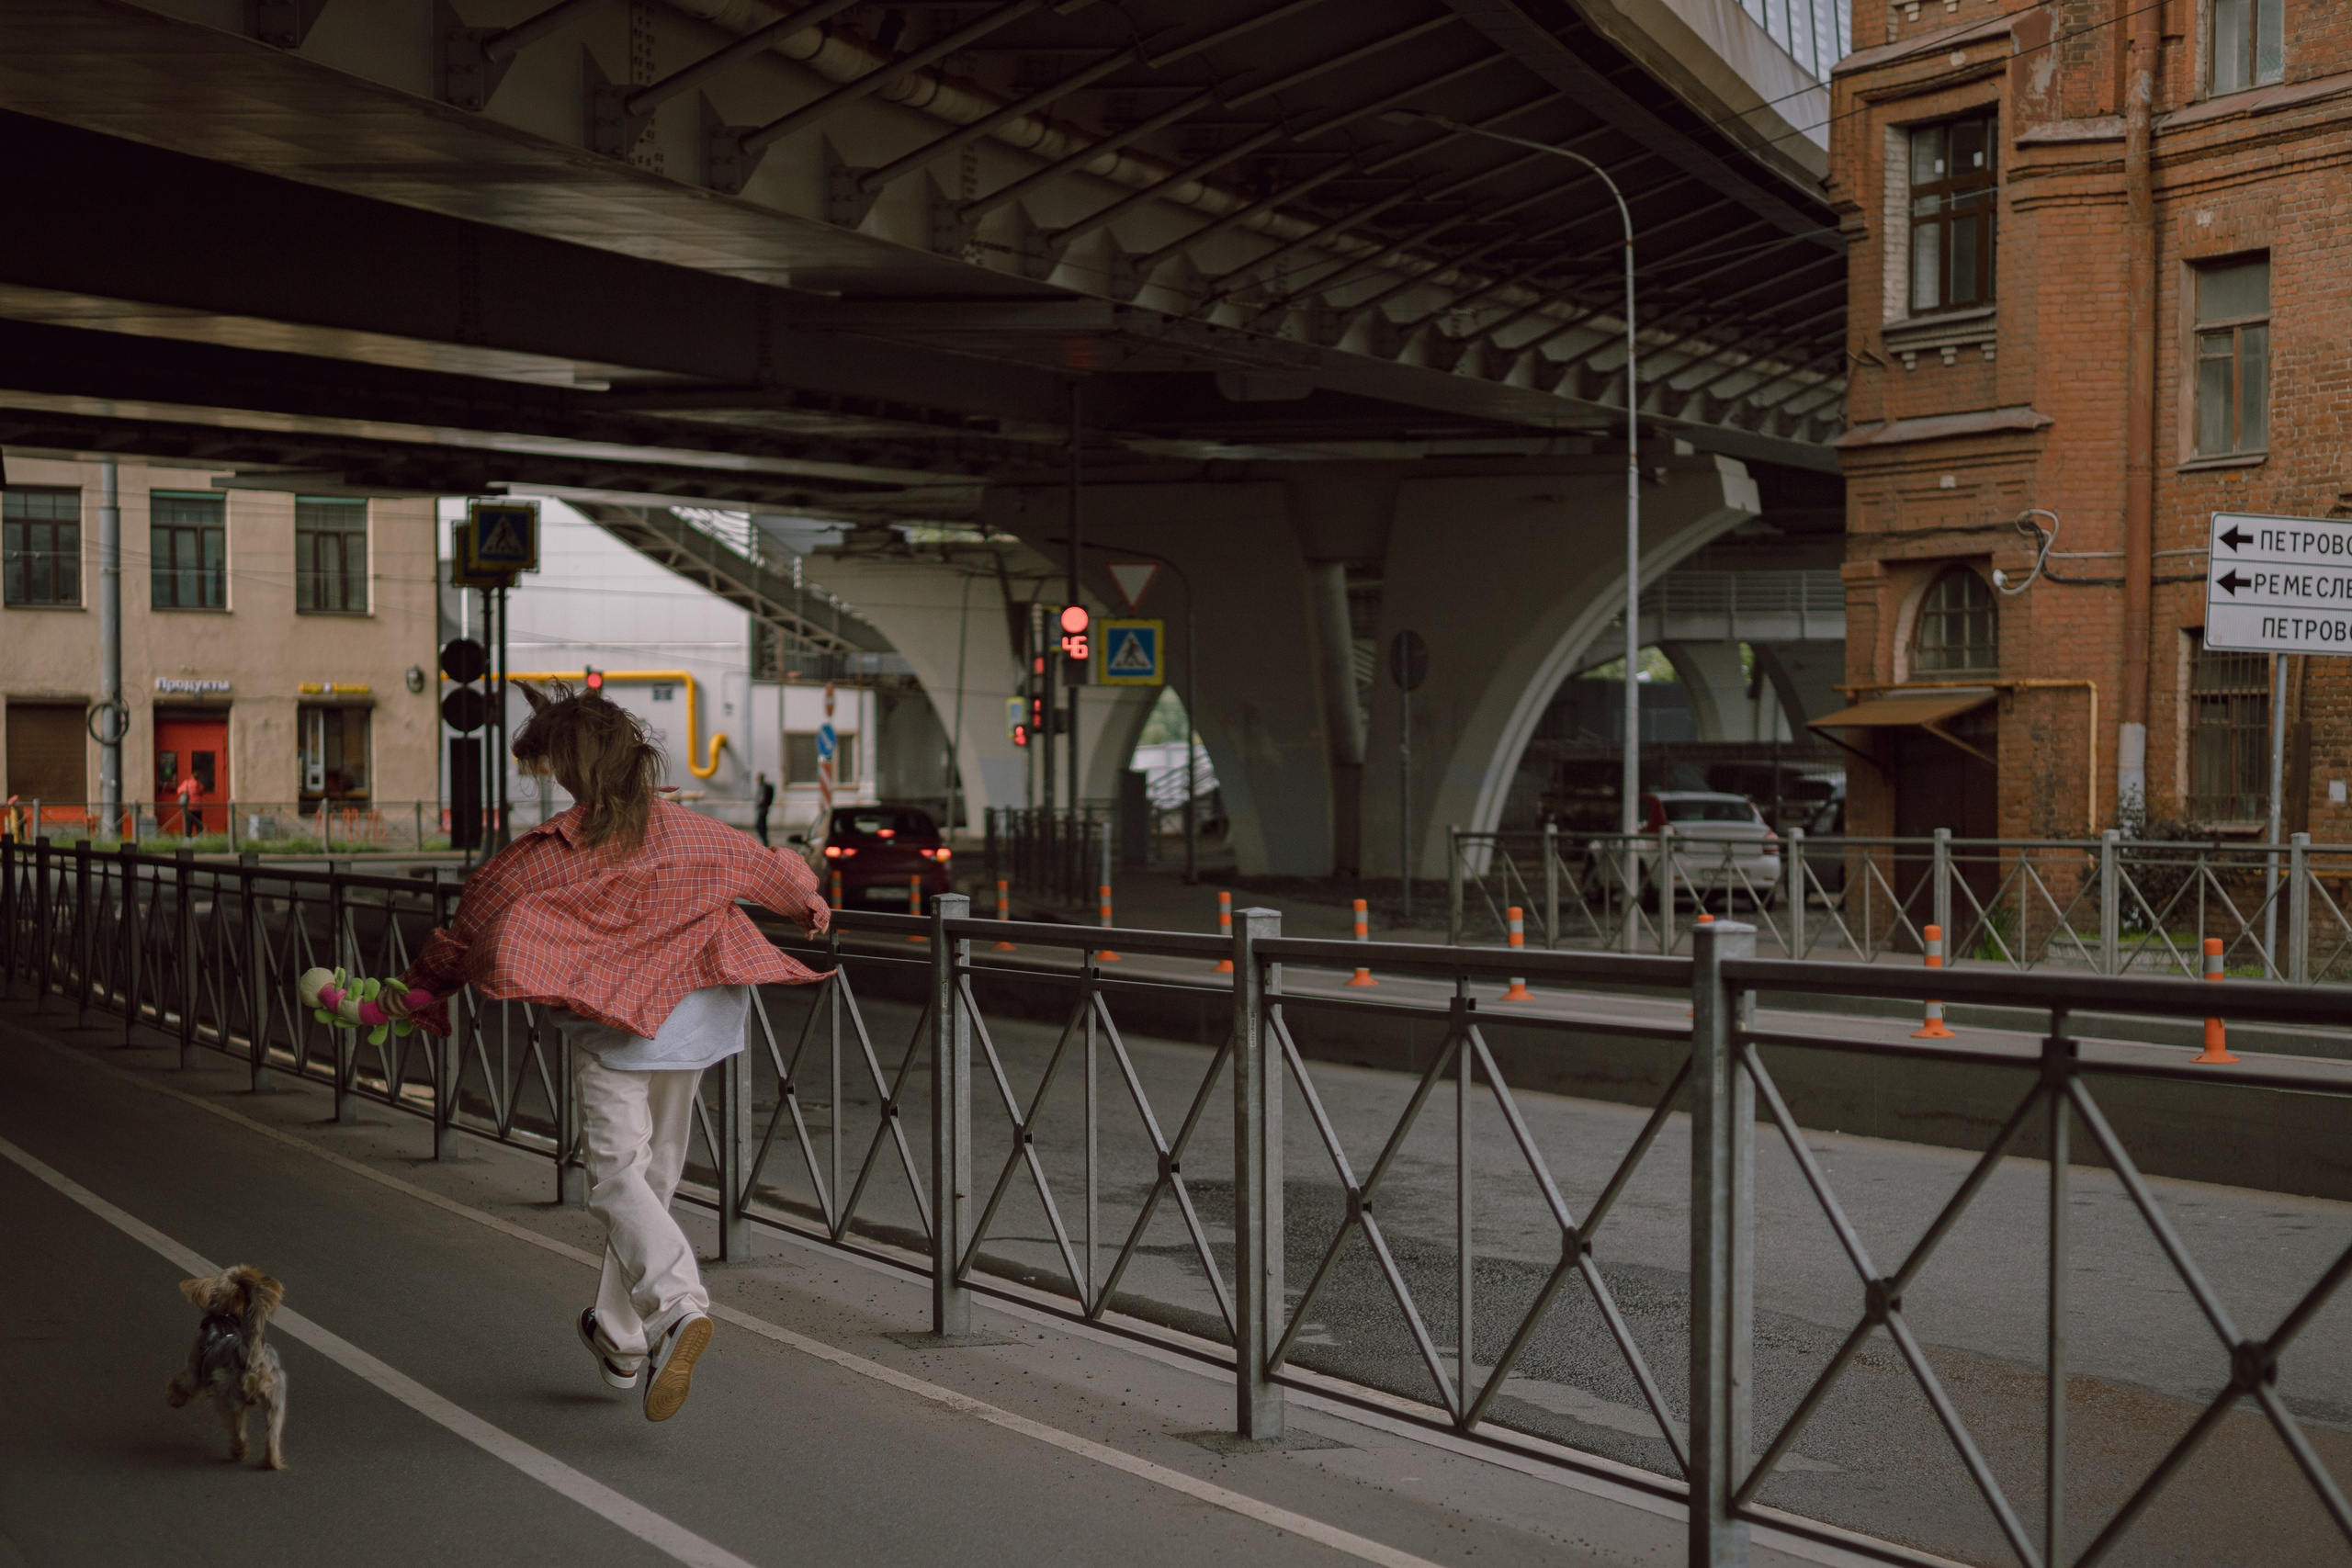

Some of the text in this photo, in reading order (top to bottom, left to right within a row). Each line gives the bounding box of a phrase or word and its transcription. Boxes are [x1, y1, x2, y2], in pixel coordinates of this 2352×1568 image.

[2262, 617, 2352, 642] ПЕТРОВ
[1061, 635, 1089, 660] 46
[154, 677, 230, 693] Продукты
